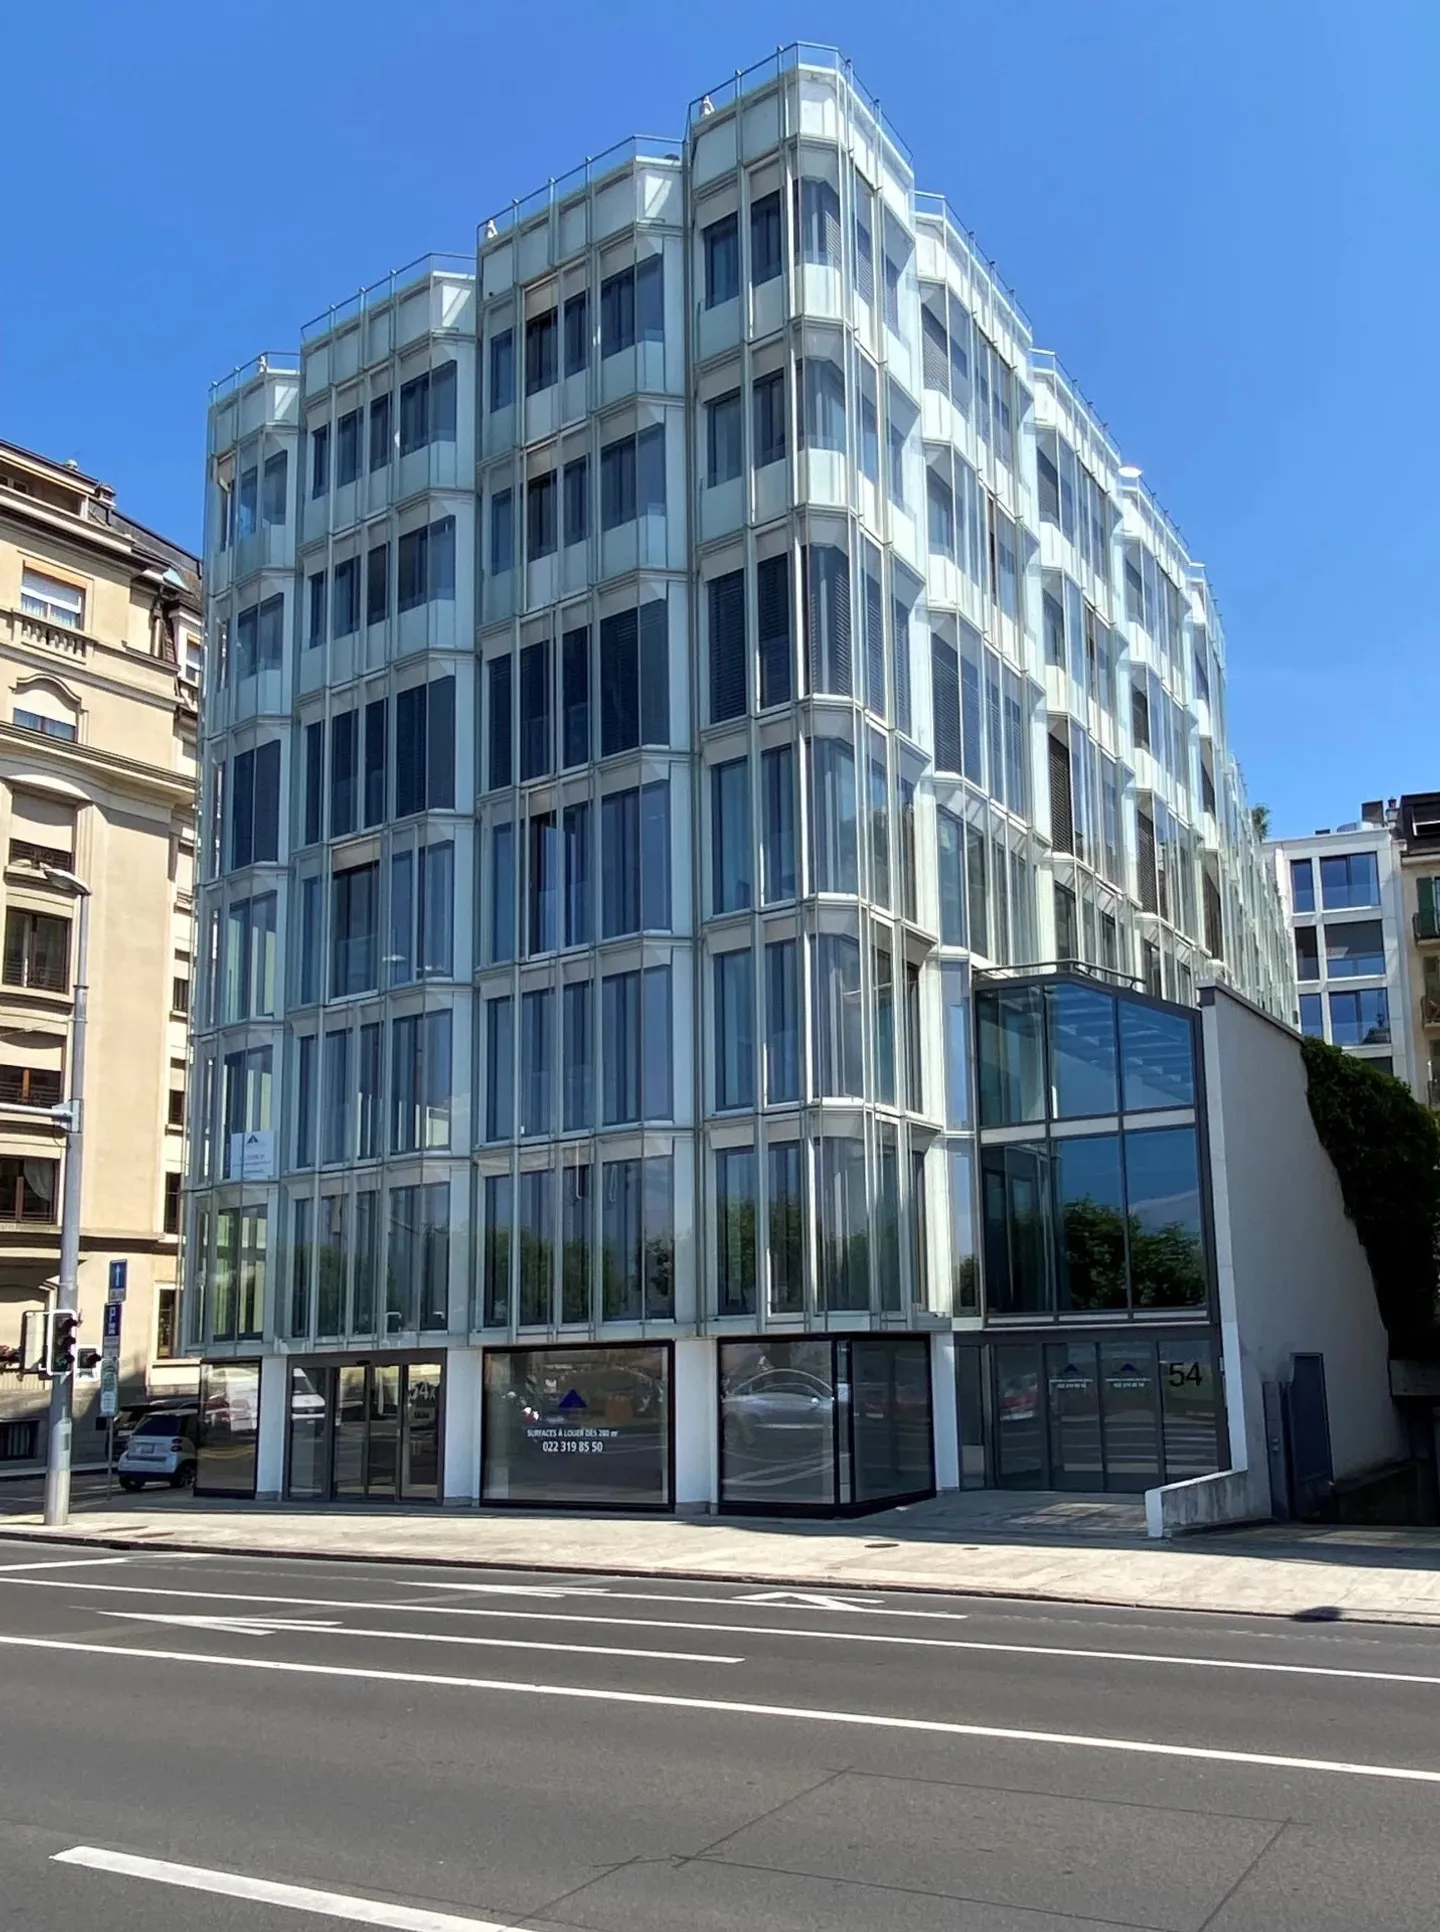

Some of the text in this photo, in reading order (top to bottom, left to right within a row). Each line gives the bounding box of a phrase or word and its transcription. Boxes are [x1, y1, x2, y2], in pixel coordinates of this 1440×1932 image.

[109, 1306, 116, 1323] P
[1169, 1362, 1202, 1387] 54
[542, 1441, 603, 1452] 022 319 85 50
